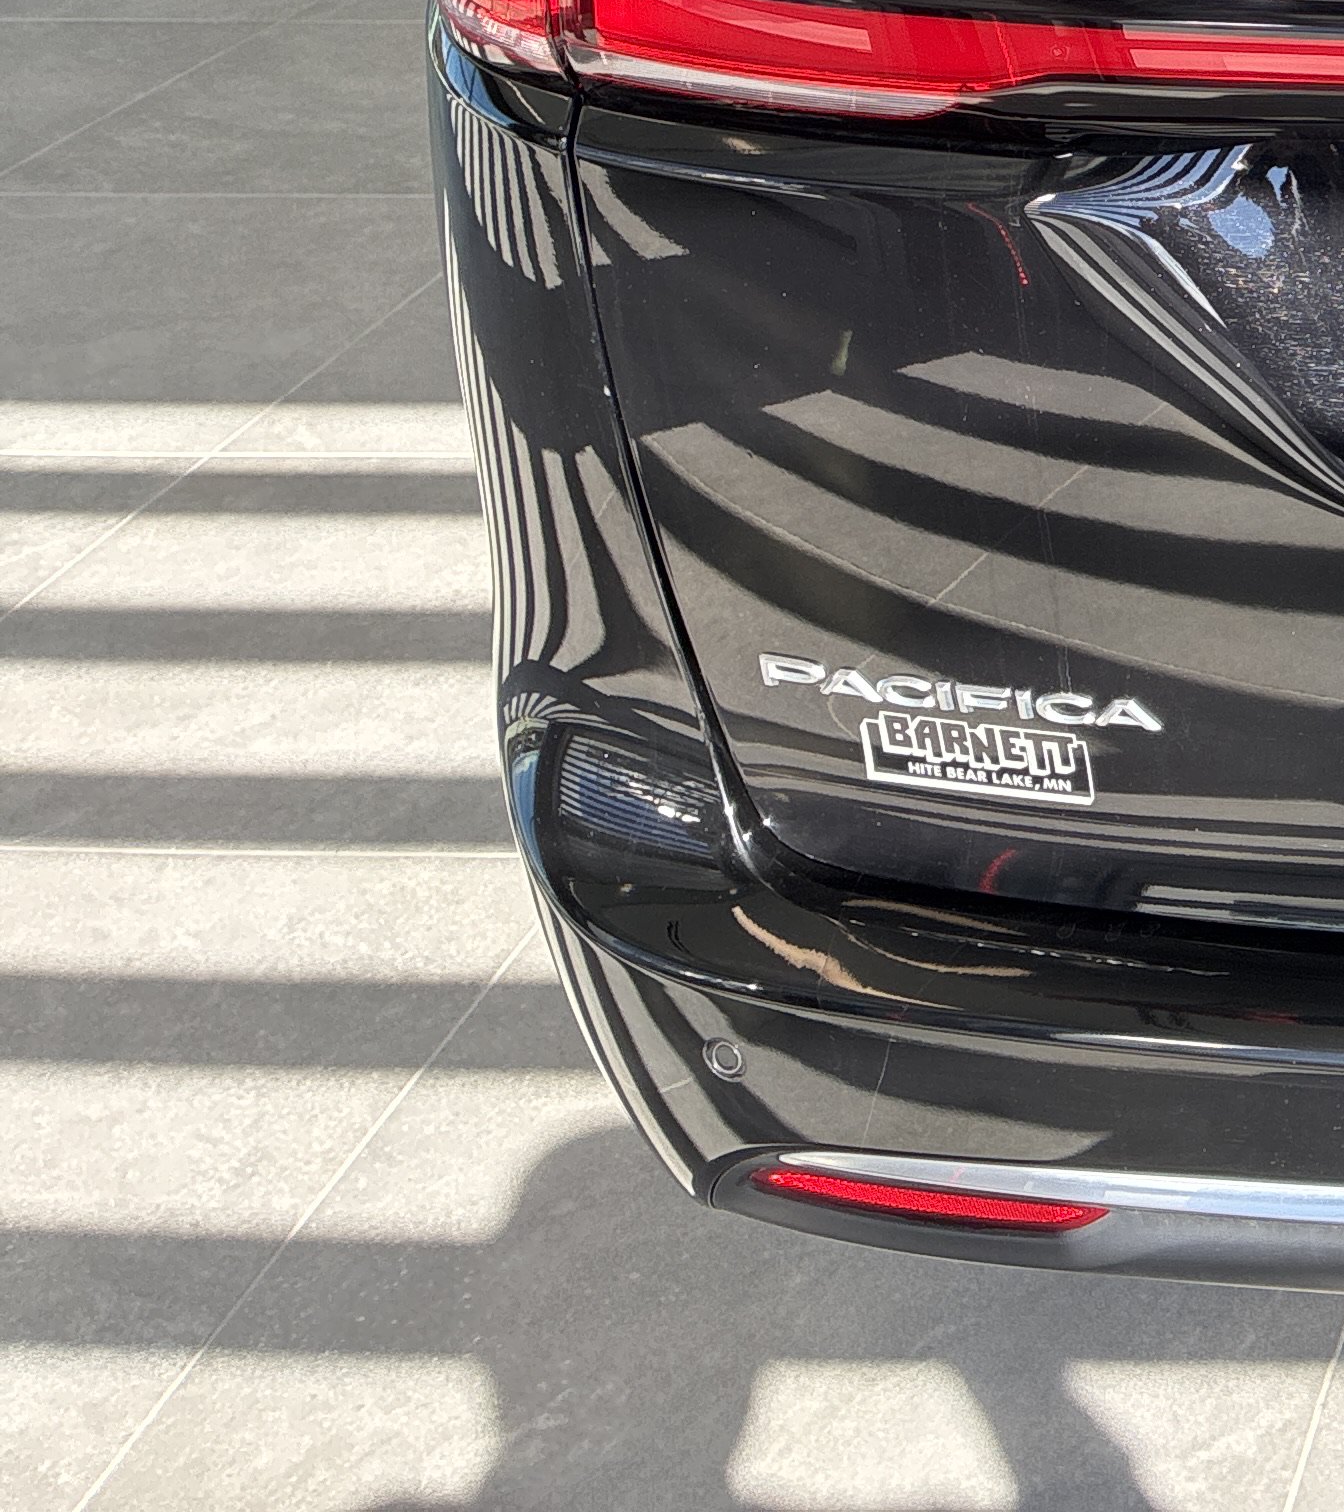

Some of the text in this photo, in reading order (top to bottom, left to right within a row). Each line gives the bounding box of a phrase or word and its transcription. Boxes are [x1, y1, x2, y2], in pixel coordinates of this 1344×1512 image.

[758, 652, 1164, 734] PACIFICA
[880, 712, 1077, 776] BARNETT
[945, 766, 989, 783] BEAR
[991, 771, 1040, 791] LAKE,
[1042, 777, 1073, 793] MN
